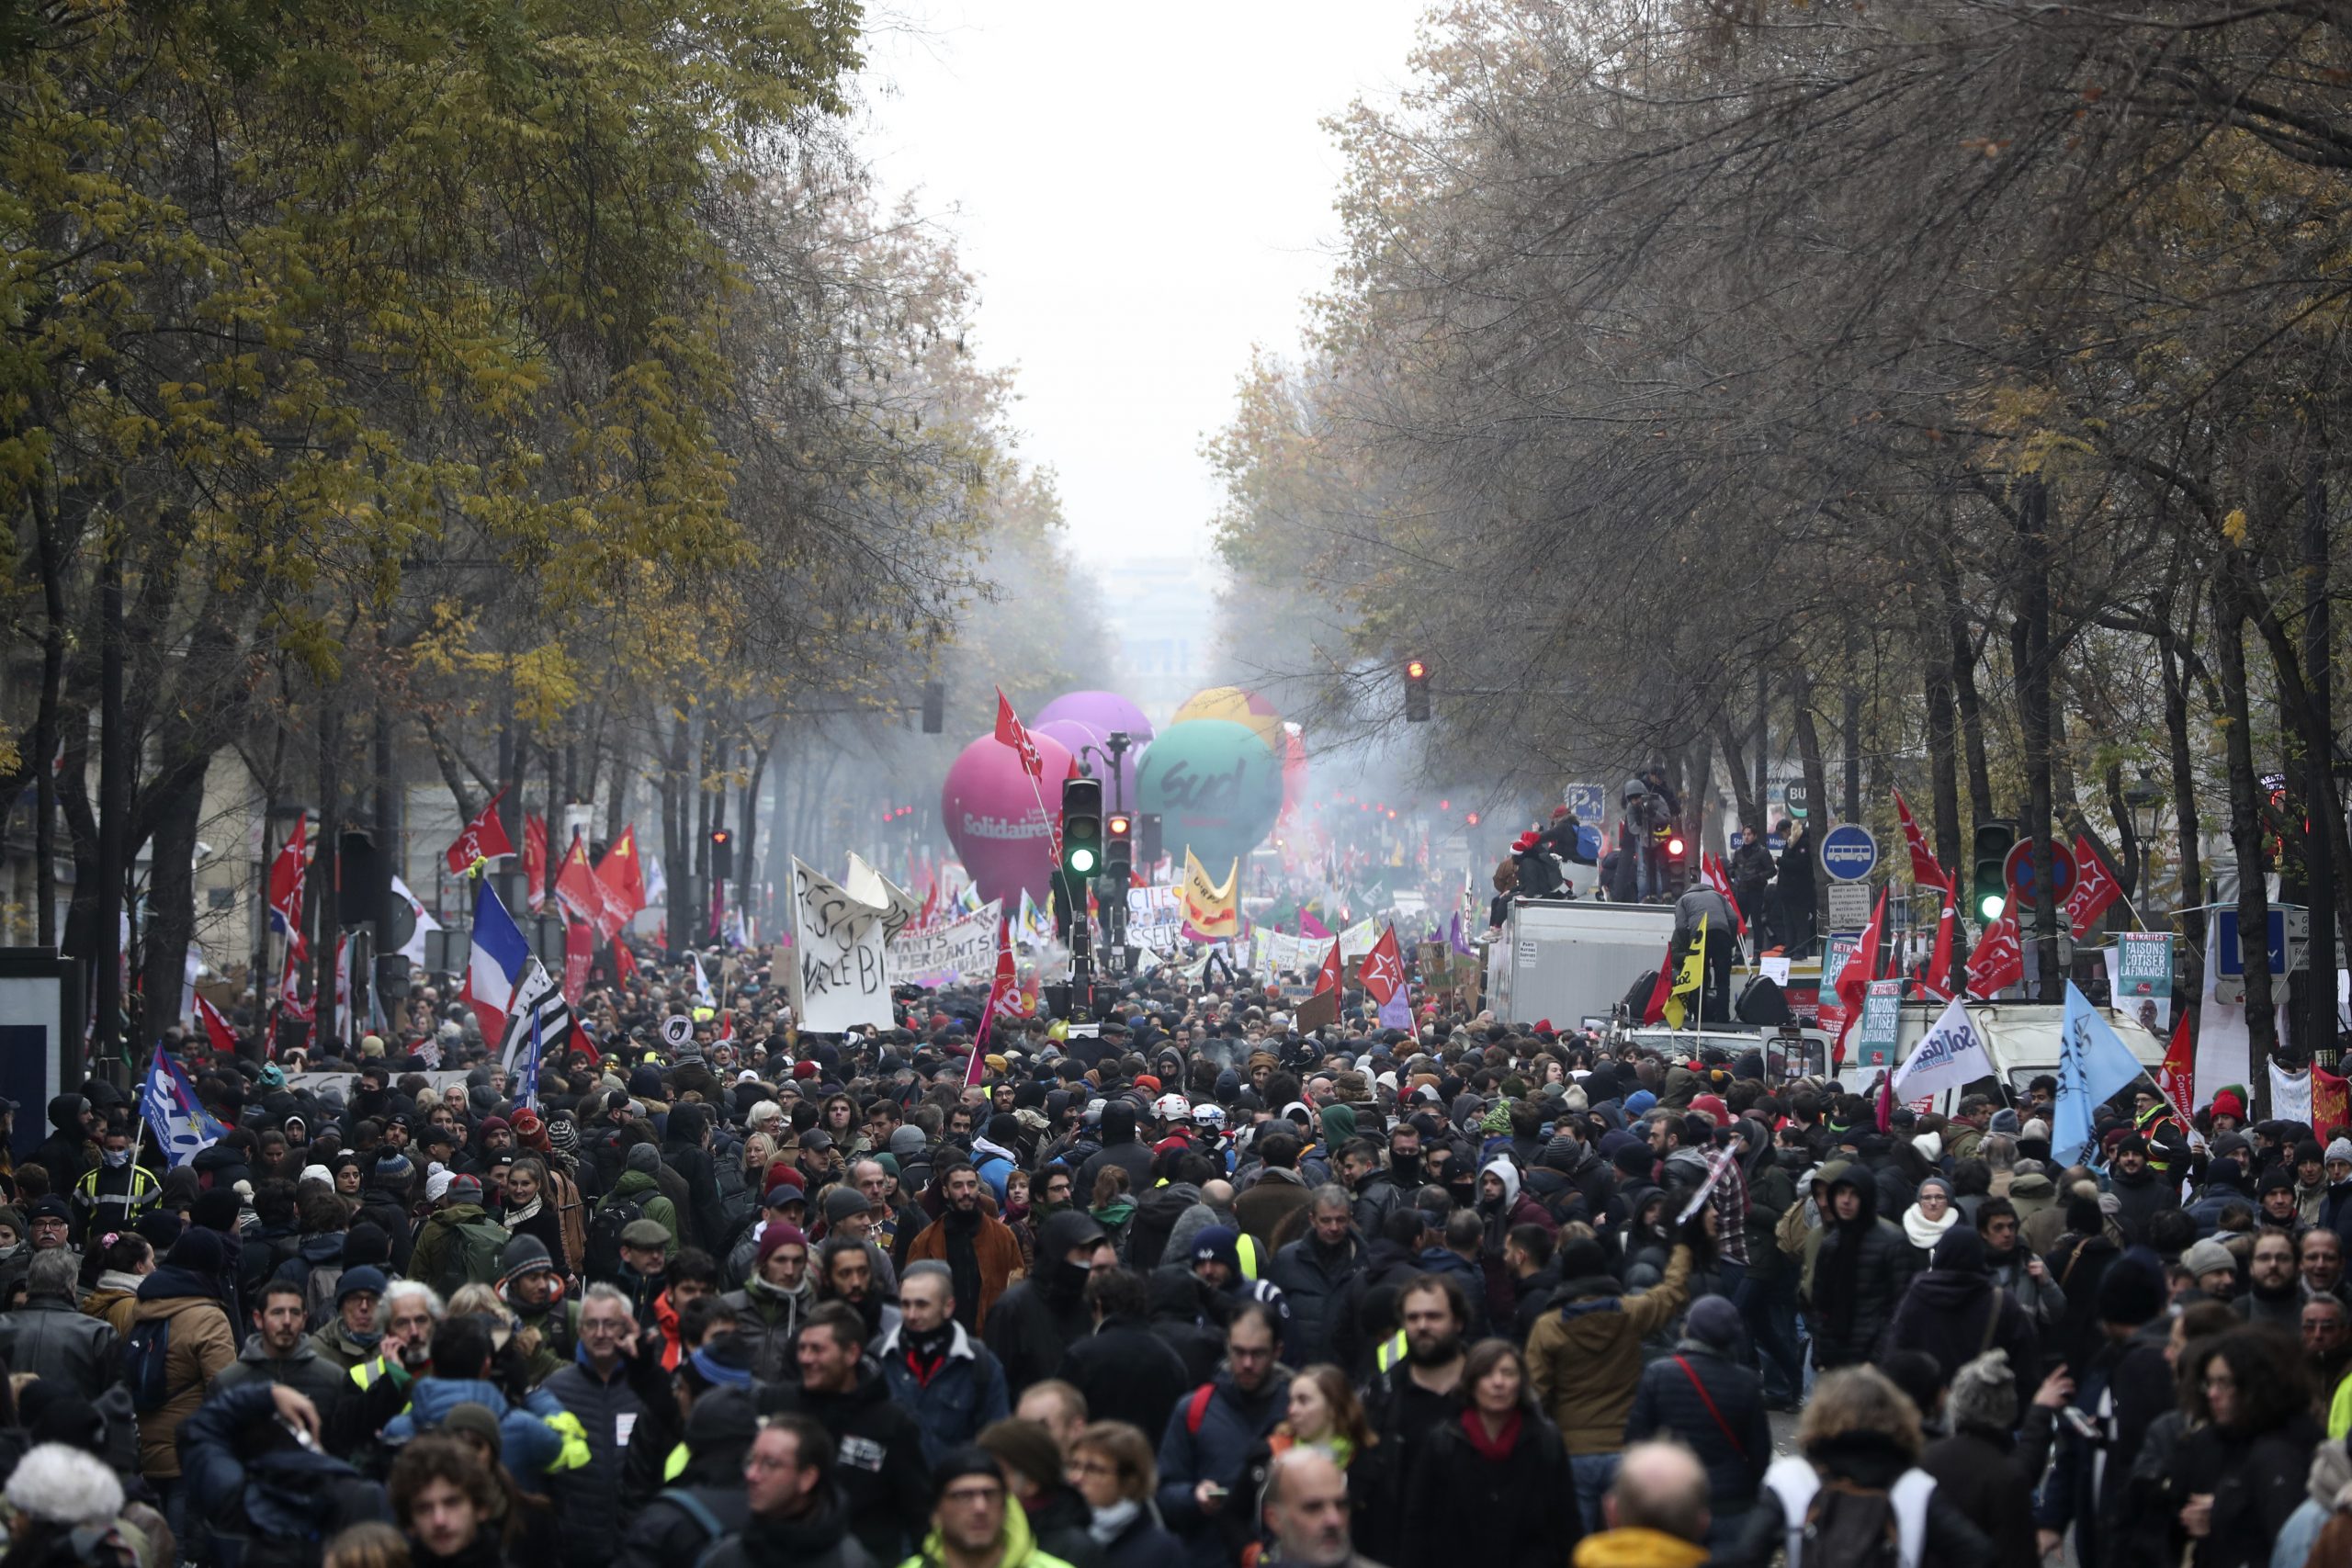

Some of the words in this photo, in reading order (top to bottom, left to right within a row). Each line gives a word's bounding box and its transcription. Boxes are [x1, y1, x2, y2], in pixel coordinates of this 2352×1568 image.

[1161, 758, 1246, 810] Sud
[2126, 942, 2165, 954] FAISONS
[2126, 954, 2165, 967] COTISER
[2120, 966, 2130, 976] LA
[2131, 966, 2165, 977] FINANCE
[1868, 998, 1898, 1015] FAISONS
[1866, 1014, 1896, 1030] COTISER
